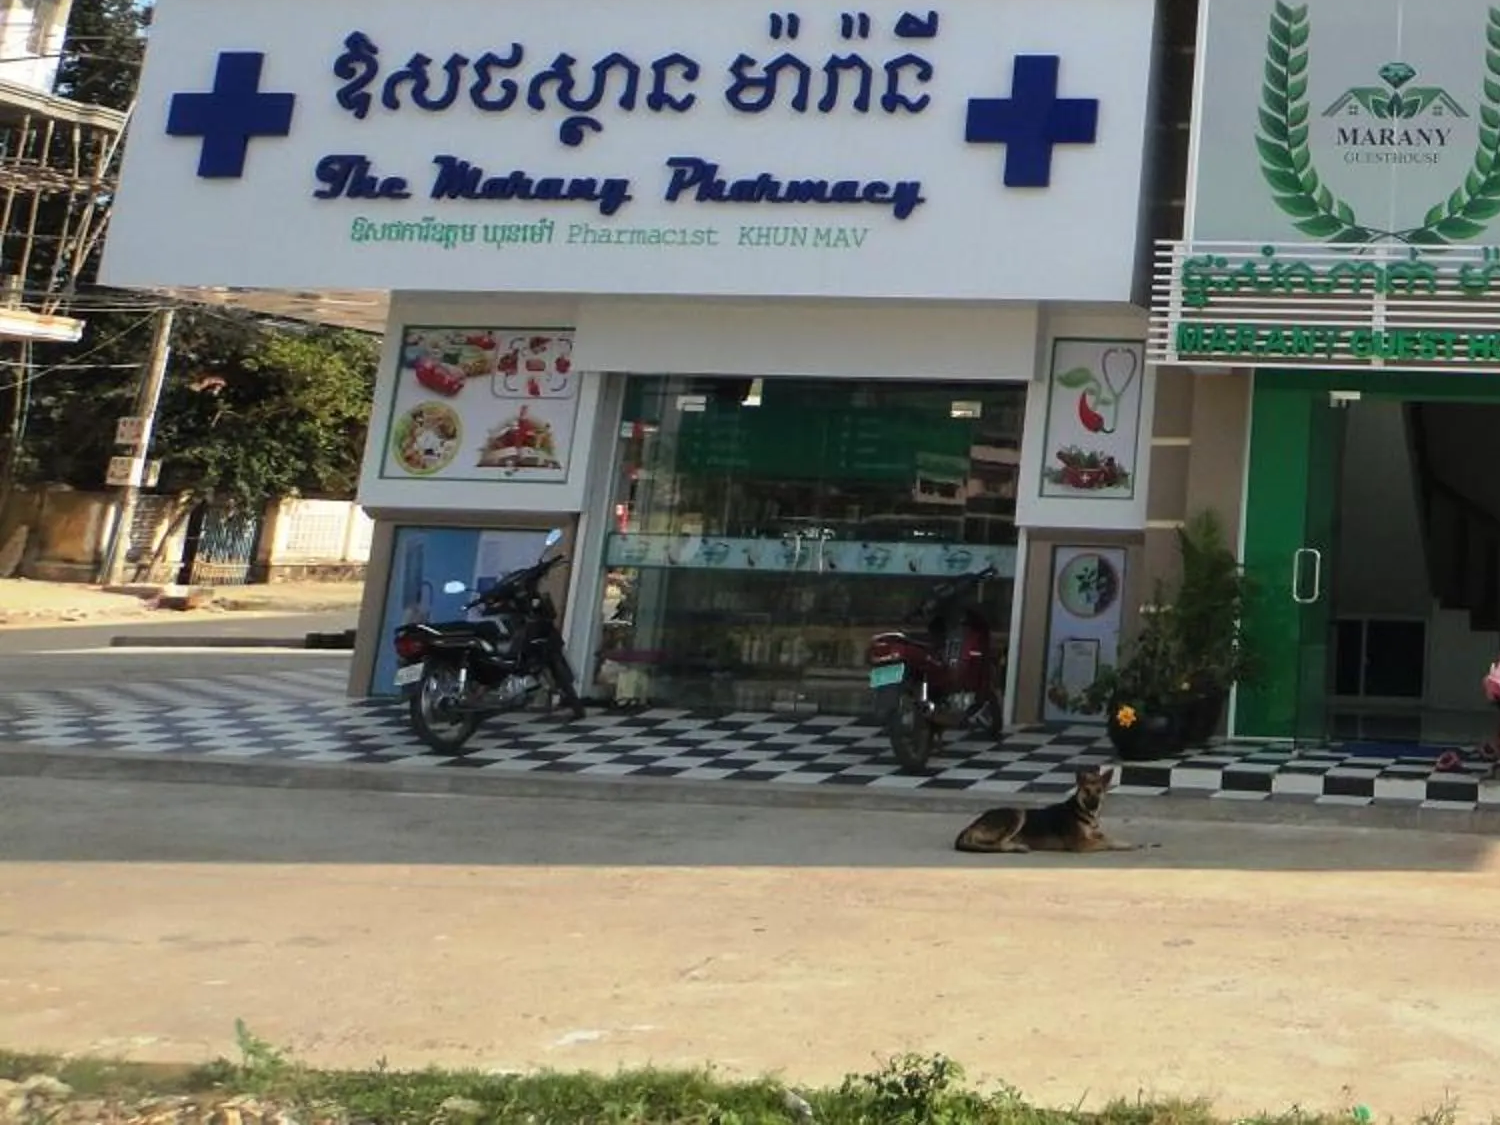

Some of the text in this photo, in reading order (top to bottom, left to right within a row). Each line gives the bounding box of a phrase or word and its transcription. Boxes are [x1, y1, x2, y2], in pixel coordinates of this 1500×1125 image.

[1336, 128, 1452, 147] MARANY
[1343, 150, 1441, 165] GUESTHOUSE
[312, 154, 925, 220] The Marany Pharmacy
[566, 223, 869, 249] Pharmacist KHUN MAV
[1176, 321, 1338, 361] MARANY
[1349, 327, 1457, 361] GUEST
